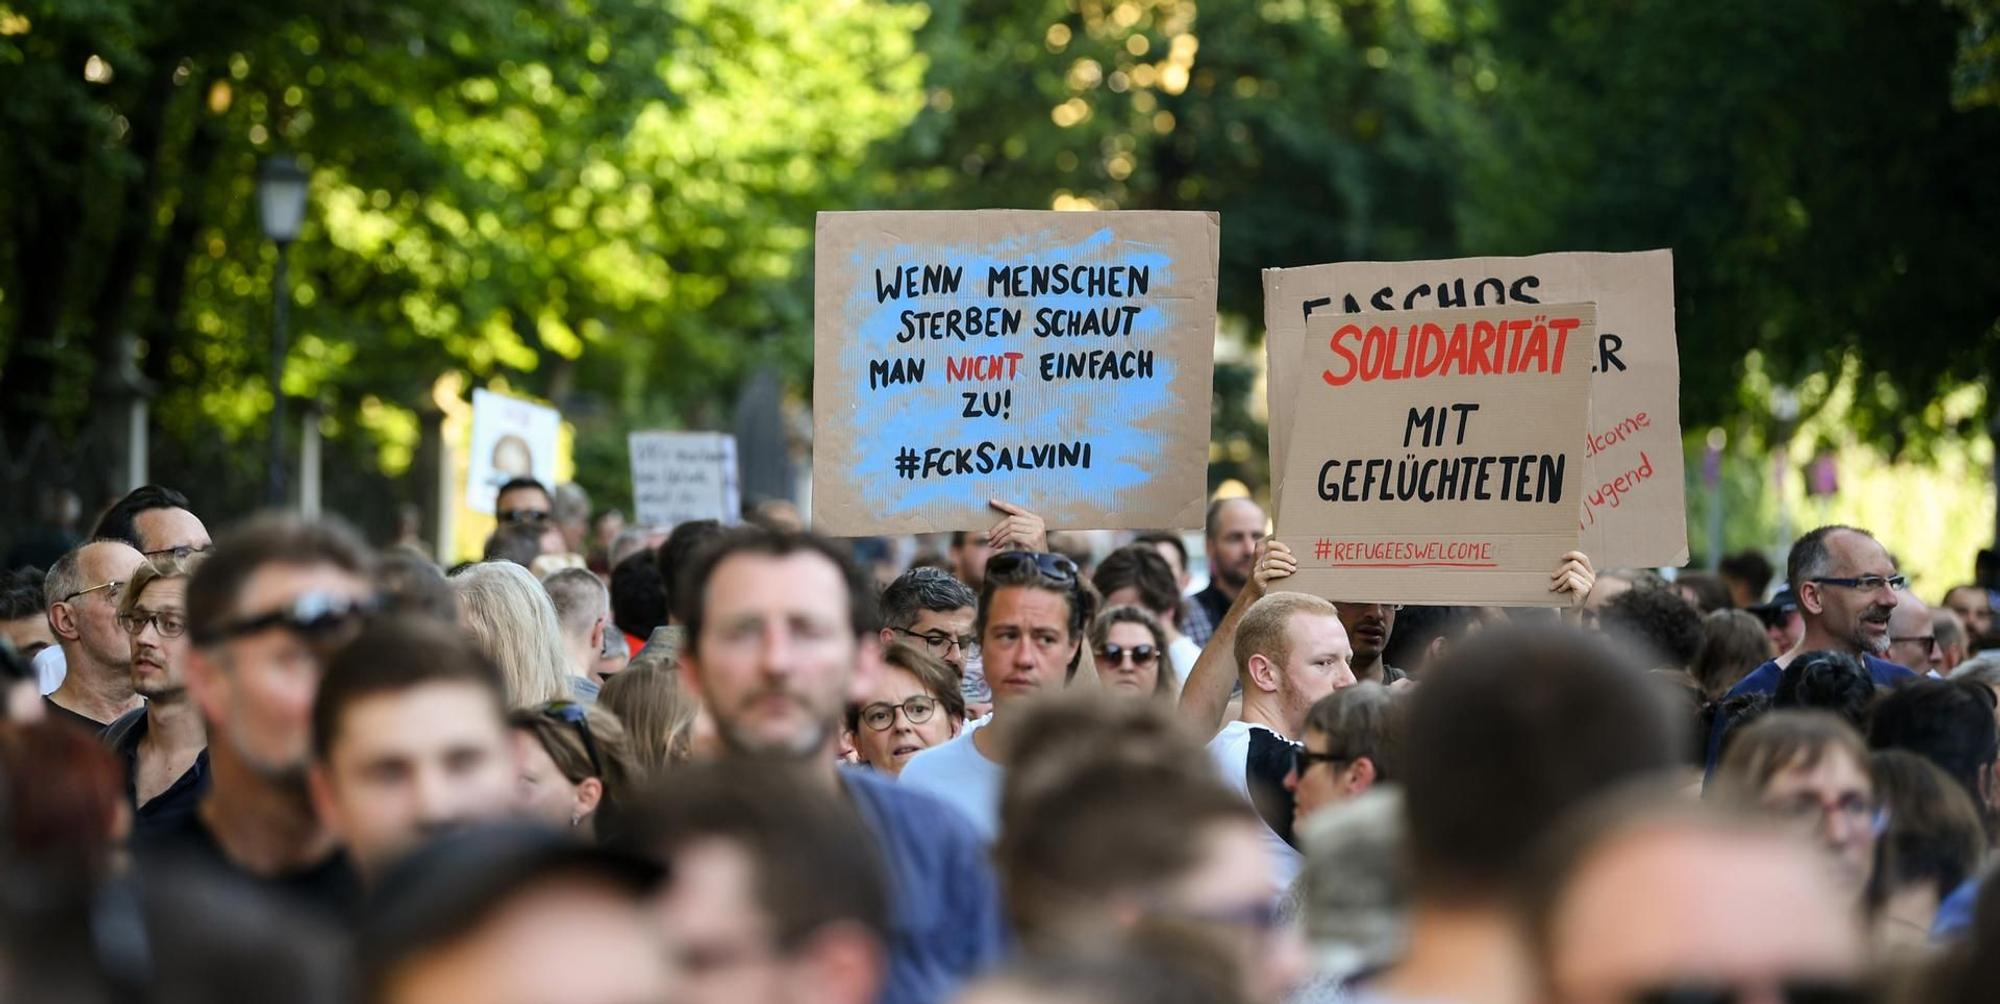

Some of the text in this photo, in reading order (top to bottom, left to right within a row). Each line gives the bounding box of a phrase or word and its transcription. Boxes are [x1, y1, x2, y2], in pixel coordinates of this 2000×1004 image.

[875, 263, 1149, 303] WENN MENSCHEN
[896, 306, 1141, 343] STERBEN SCHAUT
[869, 350, 1153, 390] MAN NICHT EINFACH
[1322, 315, 1580, 386] SOLIDARITÄT
[962, 389, 1011, 420] ZU!
[1403, 403, 1480, 447] MIT
[894, 441, 1092, 480] #FCKSALVINI
[1317, 452, 1565, 504] GEFLÜCHTETEN
[1315, 537, 1492, 562] #REFUGEESWELCOME
